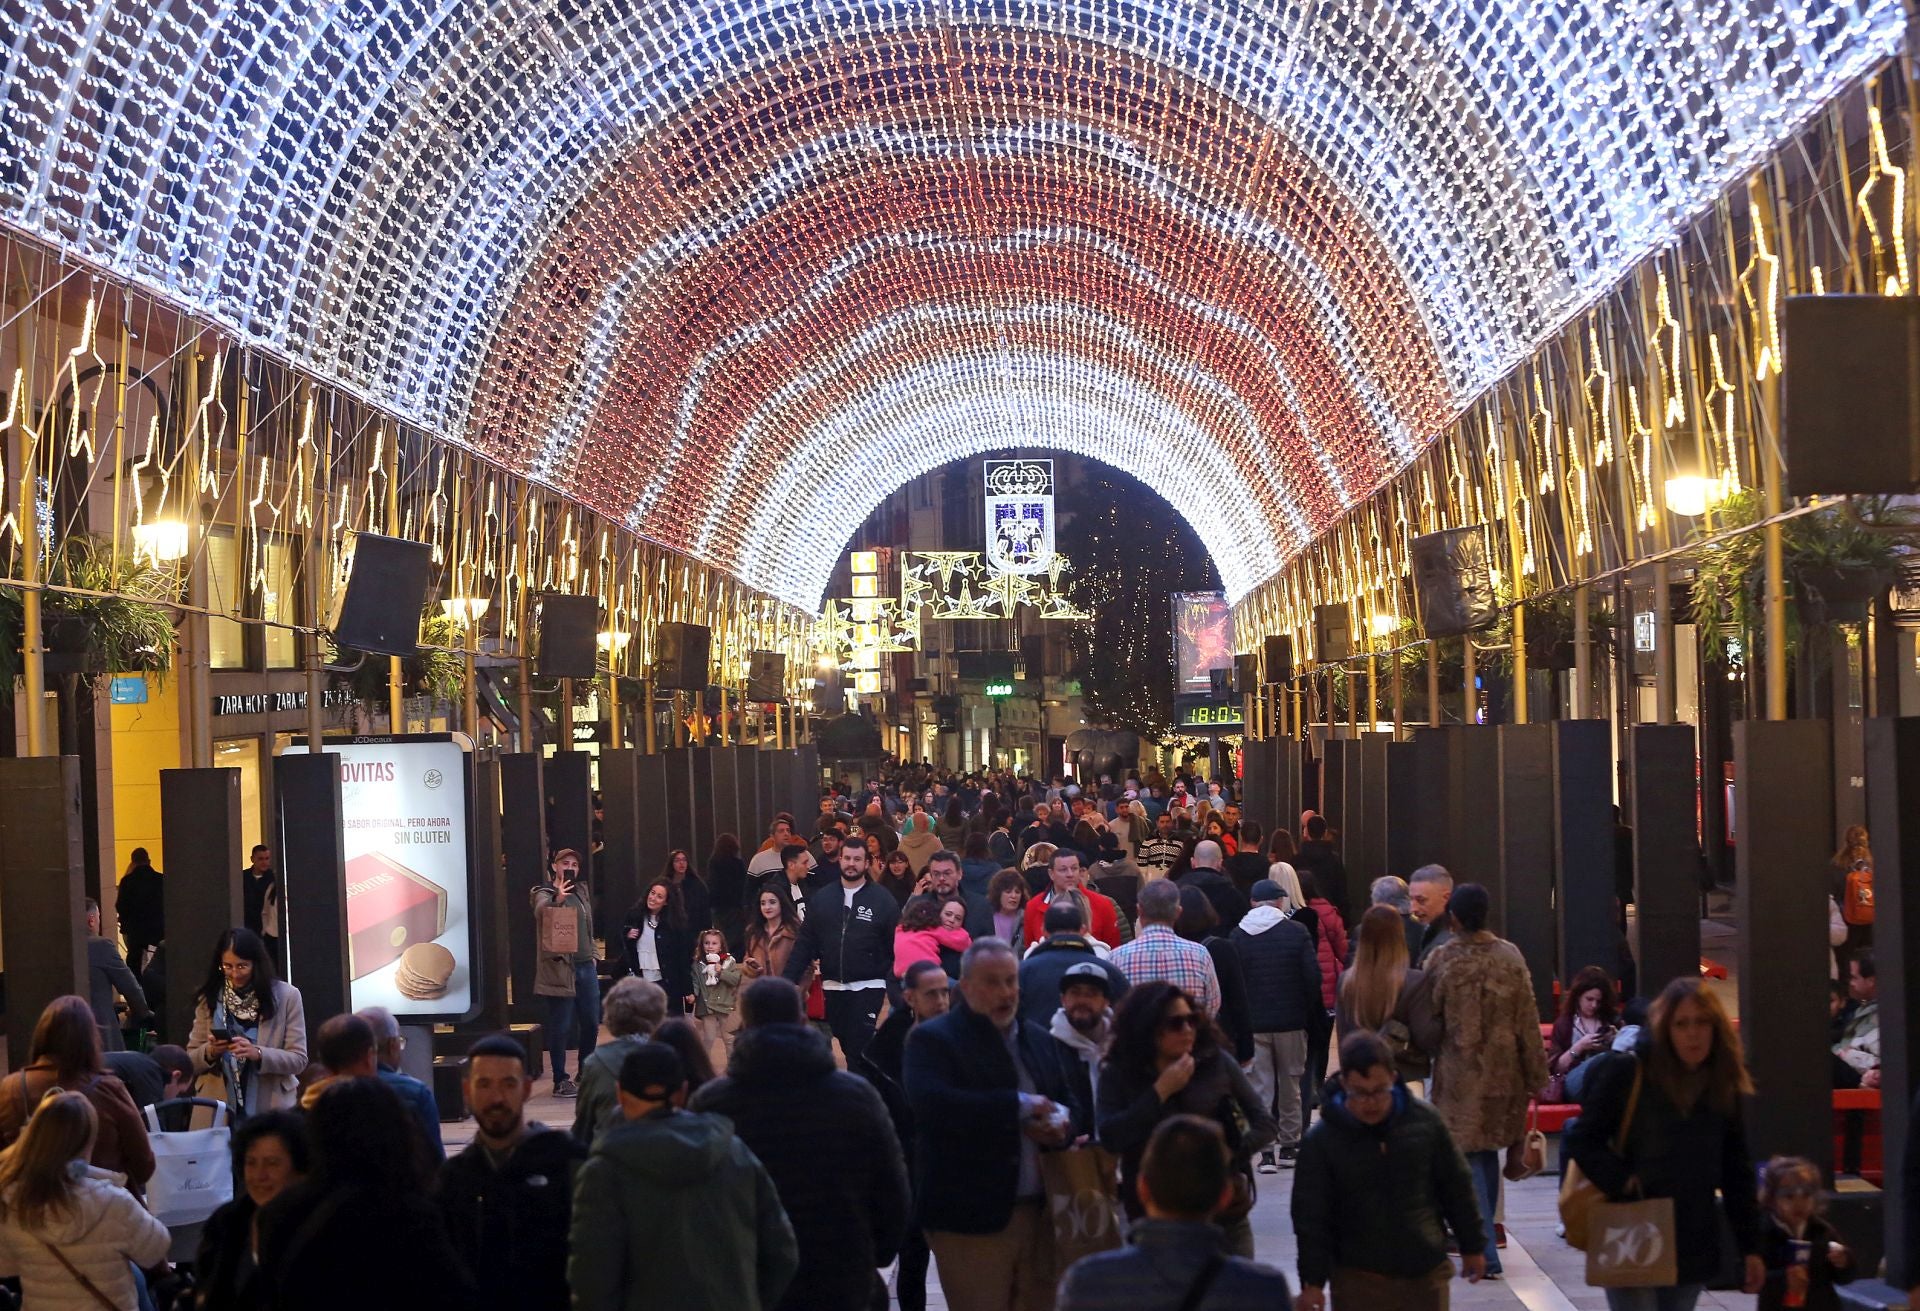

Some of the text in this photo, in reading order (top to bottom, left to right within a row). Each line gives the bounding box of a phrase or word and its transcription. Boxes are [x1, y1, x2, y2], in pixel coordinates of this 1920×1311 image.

[220, 695, 243, 715] ZARA
[276, 692, 297, 711] ZARA
[1191, 706, 1241, 723] 18:05
[352, 736, 393, 744] JCDecaux
[341, 762, 395, 783] OVITAS
[347, 818, 370, 829] SABOR
[407, 818, 425, 828] PERO
[427, 817, 451, 827] AHORA
[394, 830, 451, 845] SIN GLUTEN
